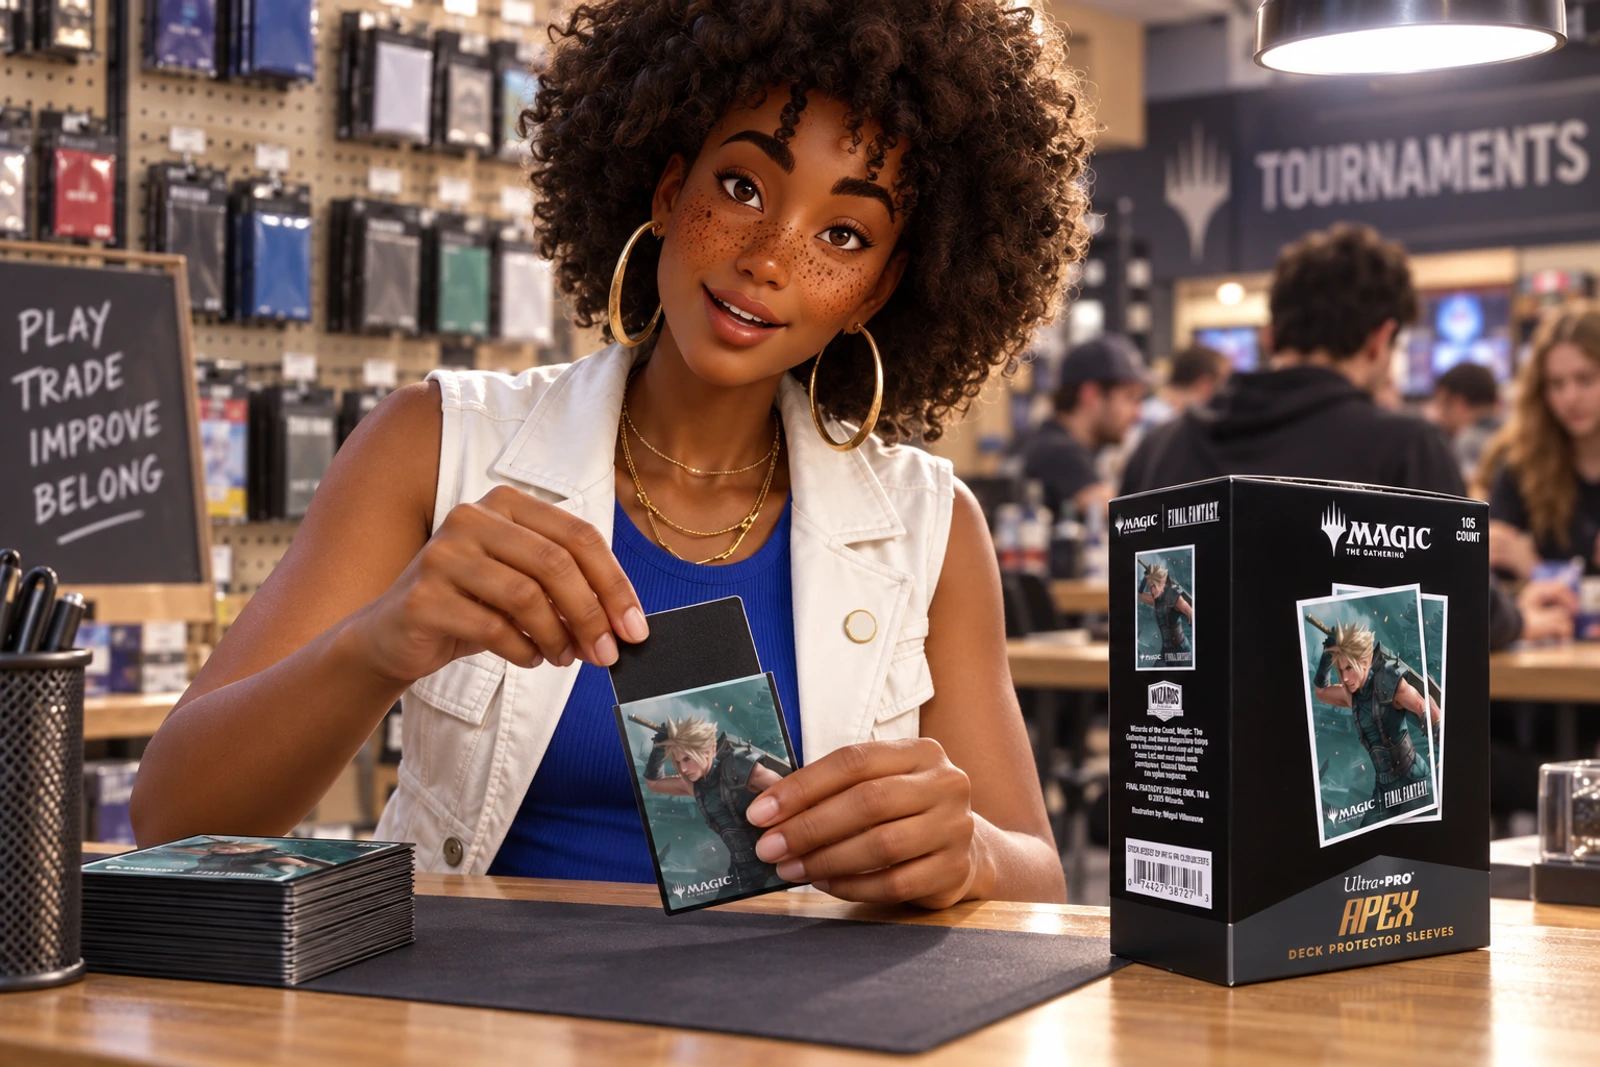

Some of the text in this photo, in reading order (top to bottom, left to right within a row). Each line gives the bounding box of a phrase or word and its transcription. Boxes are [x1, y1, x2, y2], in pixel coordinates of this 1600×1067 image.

[1256, 119, 1589, 212] TOURNAMENTS
[18, 300, 111, 353] PLAY
[11, 351, 124, 411] TRADE
[30, 399, 161, 467] IMPROVE
[33, 454, 163, 525] BELONG
[1123, 501, 1219, 530] MAGIC FINAL FANTASY
[1461, 517, 1476, 529] 105
[1346, 520, 1431, 552] MAGIC
[1455, 531, 1480, 543] COUNT
[1346, 548, 1404, 559] THE GATHERING
[1151, 686, 1179, 705] WIZARDS
[1338, 798, 1376, 820] MAGIC
[687, 875, 732, 895] MAGIC
[1128, 878, 1209, 902] 0 74427 38727 3
[1338, 890, 1419, 936] APEX
[1288, 926, 1454, 960] DECK PROTECTOR SLEEVES
